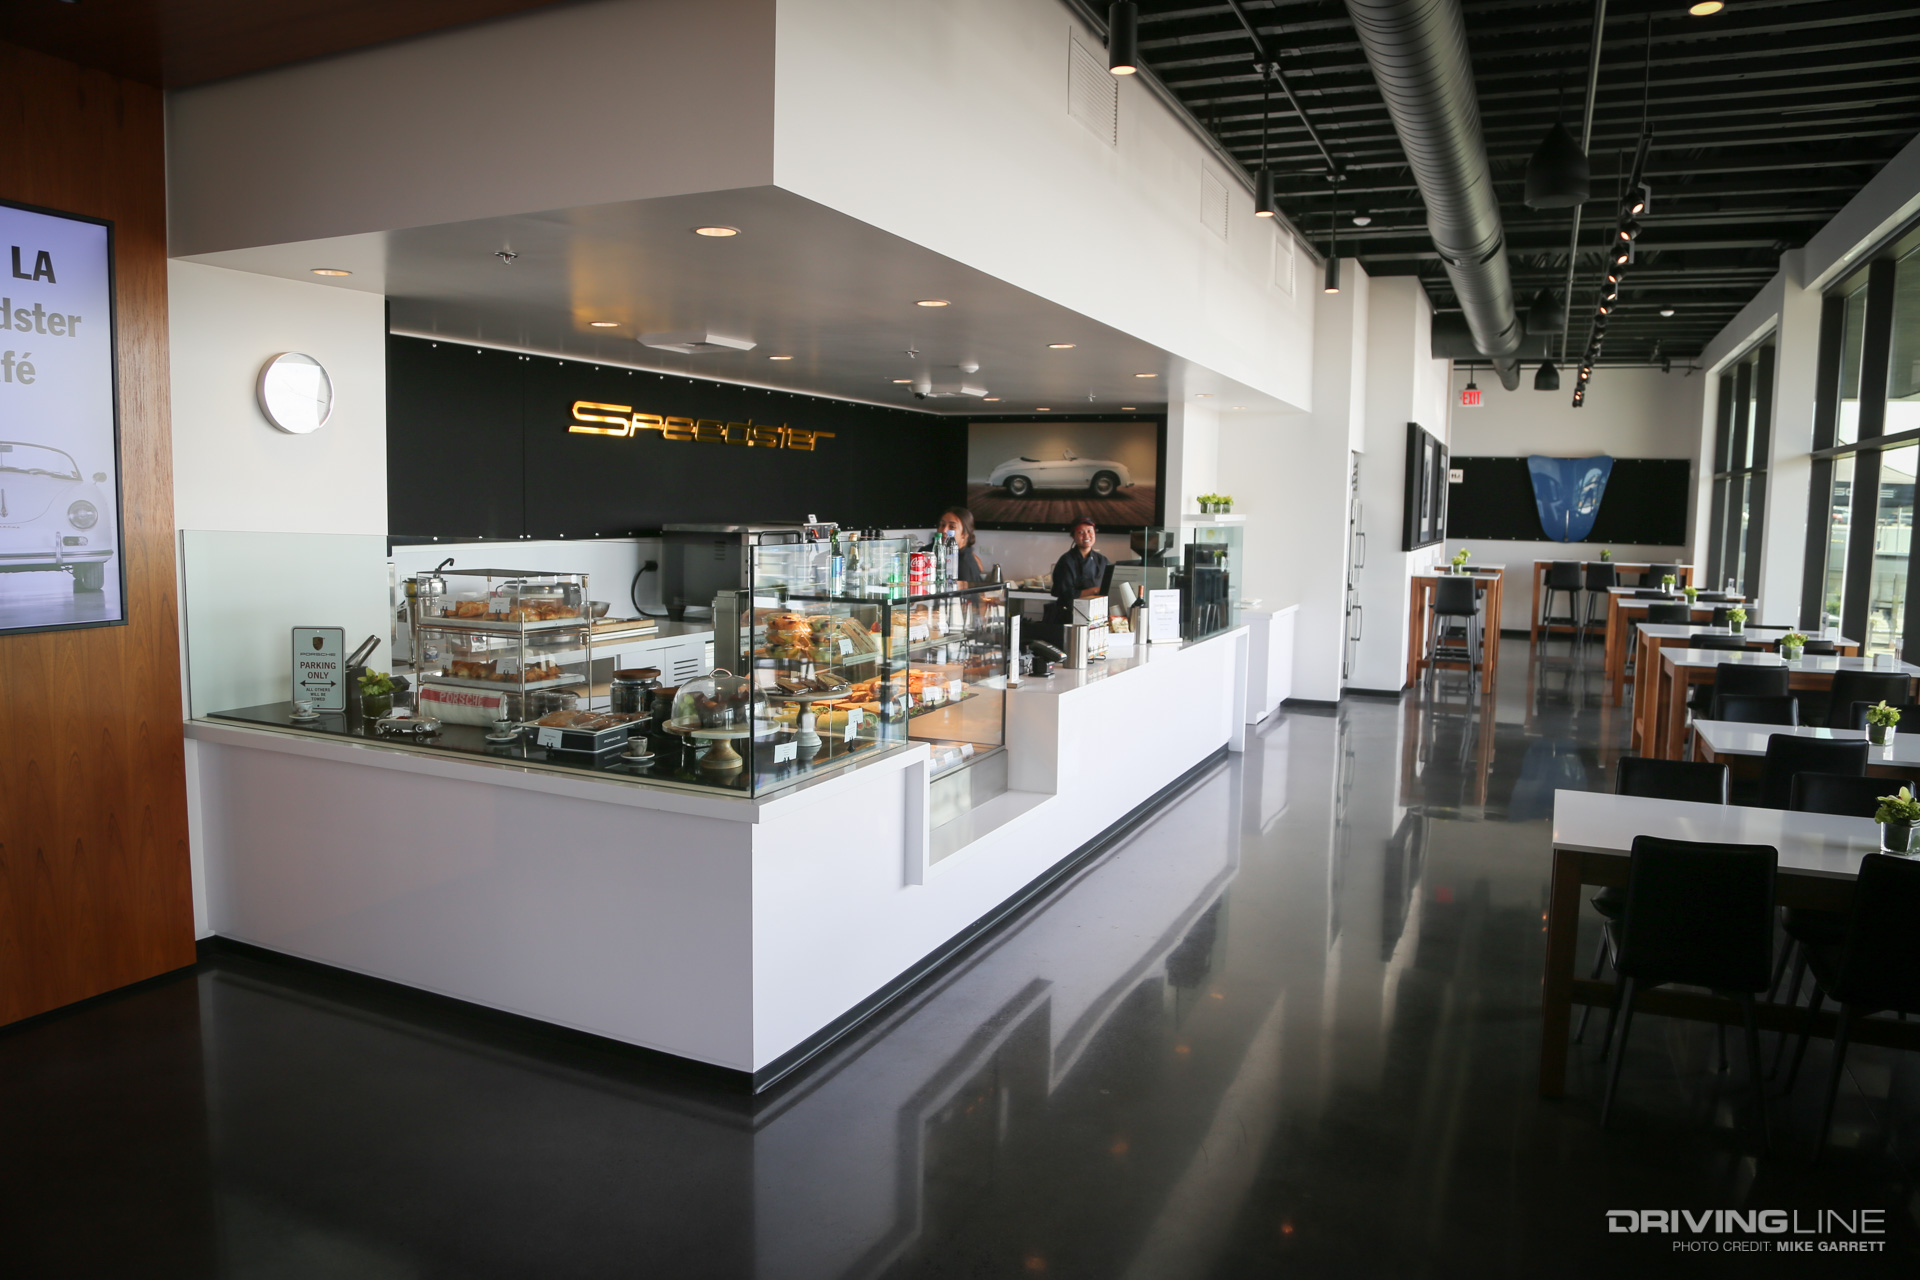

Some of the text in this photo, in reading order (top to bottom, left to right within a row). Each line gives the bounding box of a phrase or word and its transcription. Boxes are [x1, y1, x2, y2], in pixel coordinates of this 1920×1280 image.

[11, 245, 57, 284] LA
[1462, 390, 1482, 405] EXIT
[300, 661, 336, 670] PARKING
[307, 671, 329, 679] ONLY
[439, 691, 484, 706] PORSCHE
